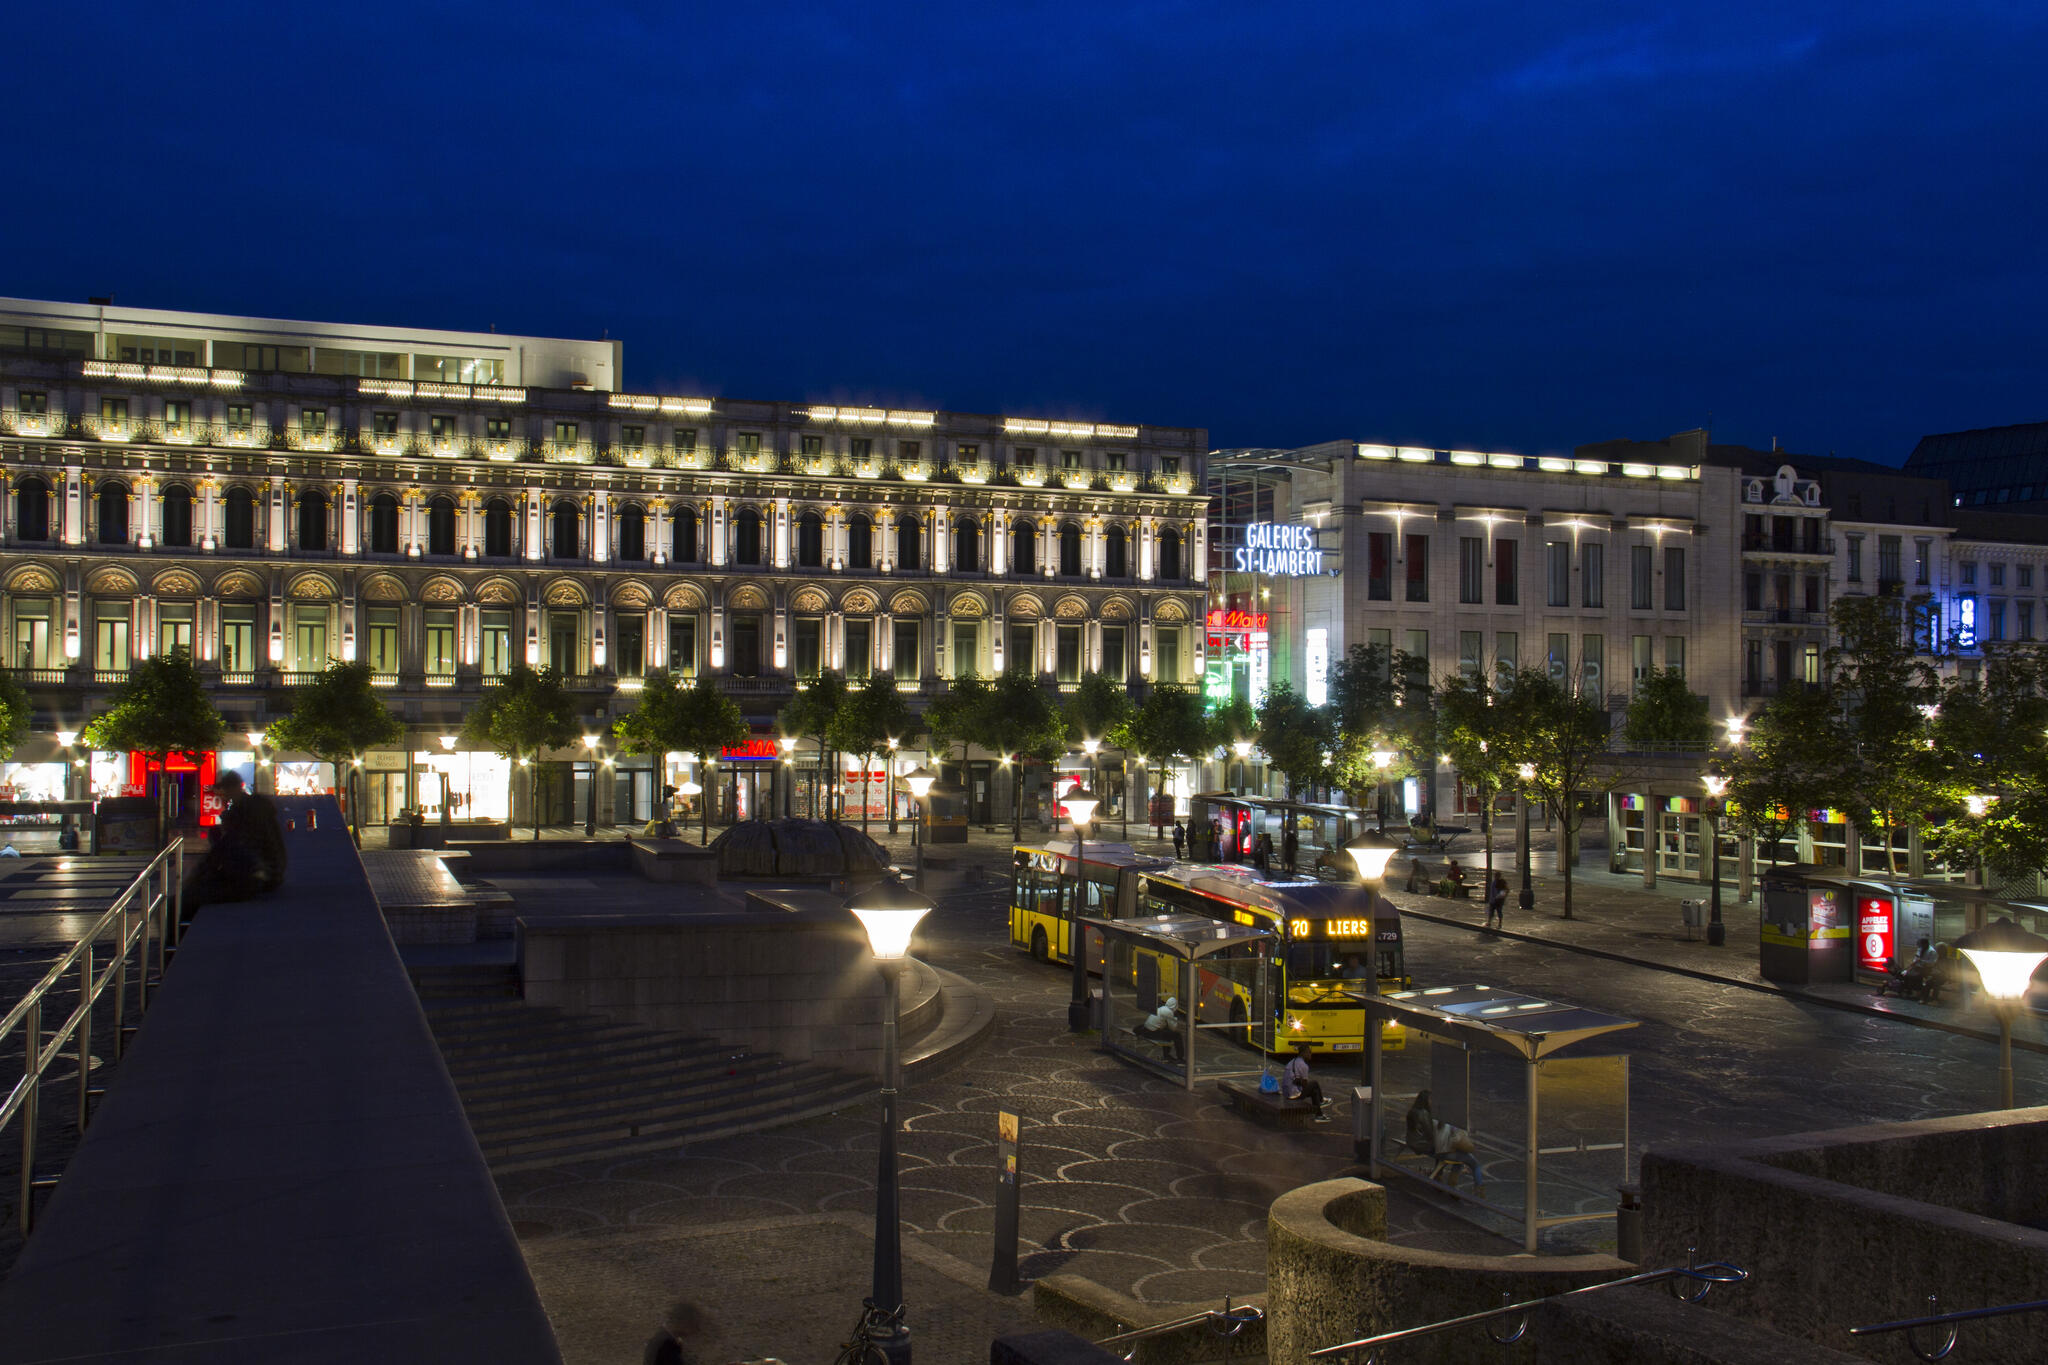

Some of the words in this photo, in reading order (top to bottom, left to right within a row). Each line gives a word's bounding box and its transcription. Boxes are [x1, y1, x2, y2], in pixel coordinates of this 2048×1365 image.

[1247, 523, 1312, 550] GALERIES
[1235, 547, 1323, 575] ST-LAMBERT
[121, 784, 144, 793] SALE
[1291, 920, 1308, 937] 70
[1327, 920, 1368, 936] LIERS
[1381, 932, 1398, 941] 729
